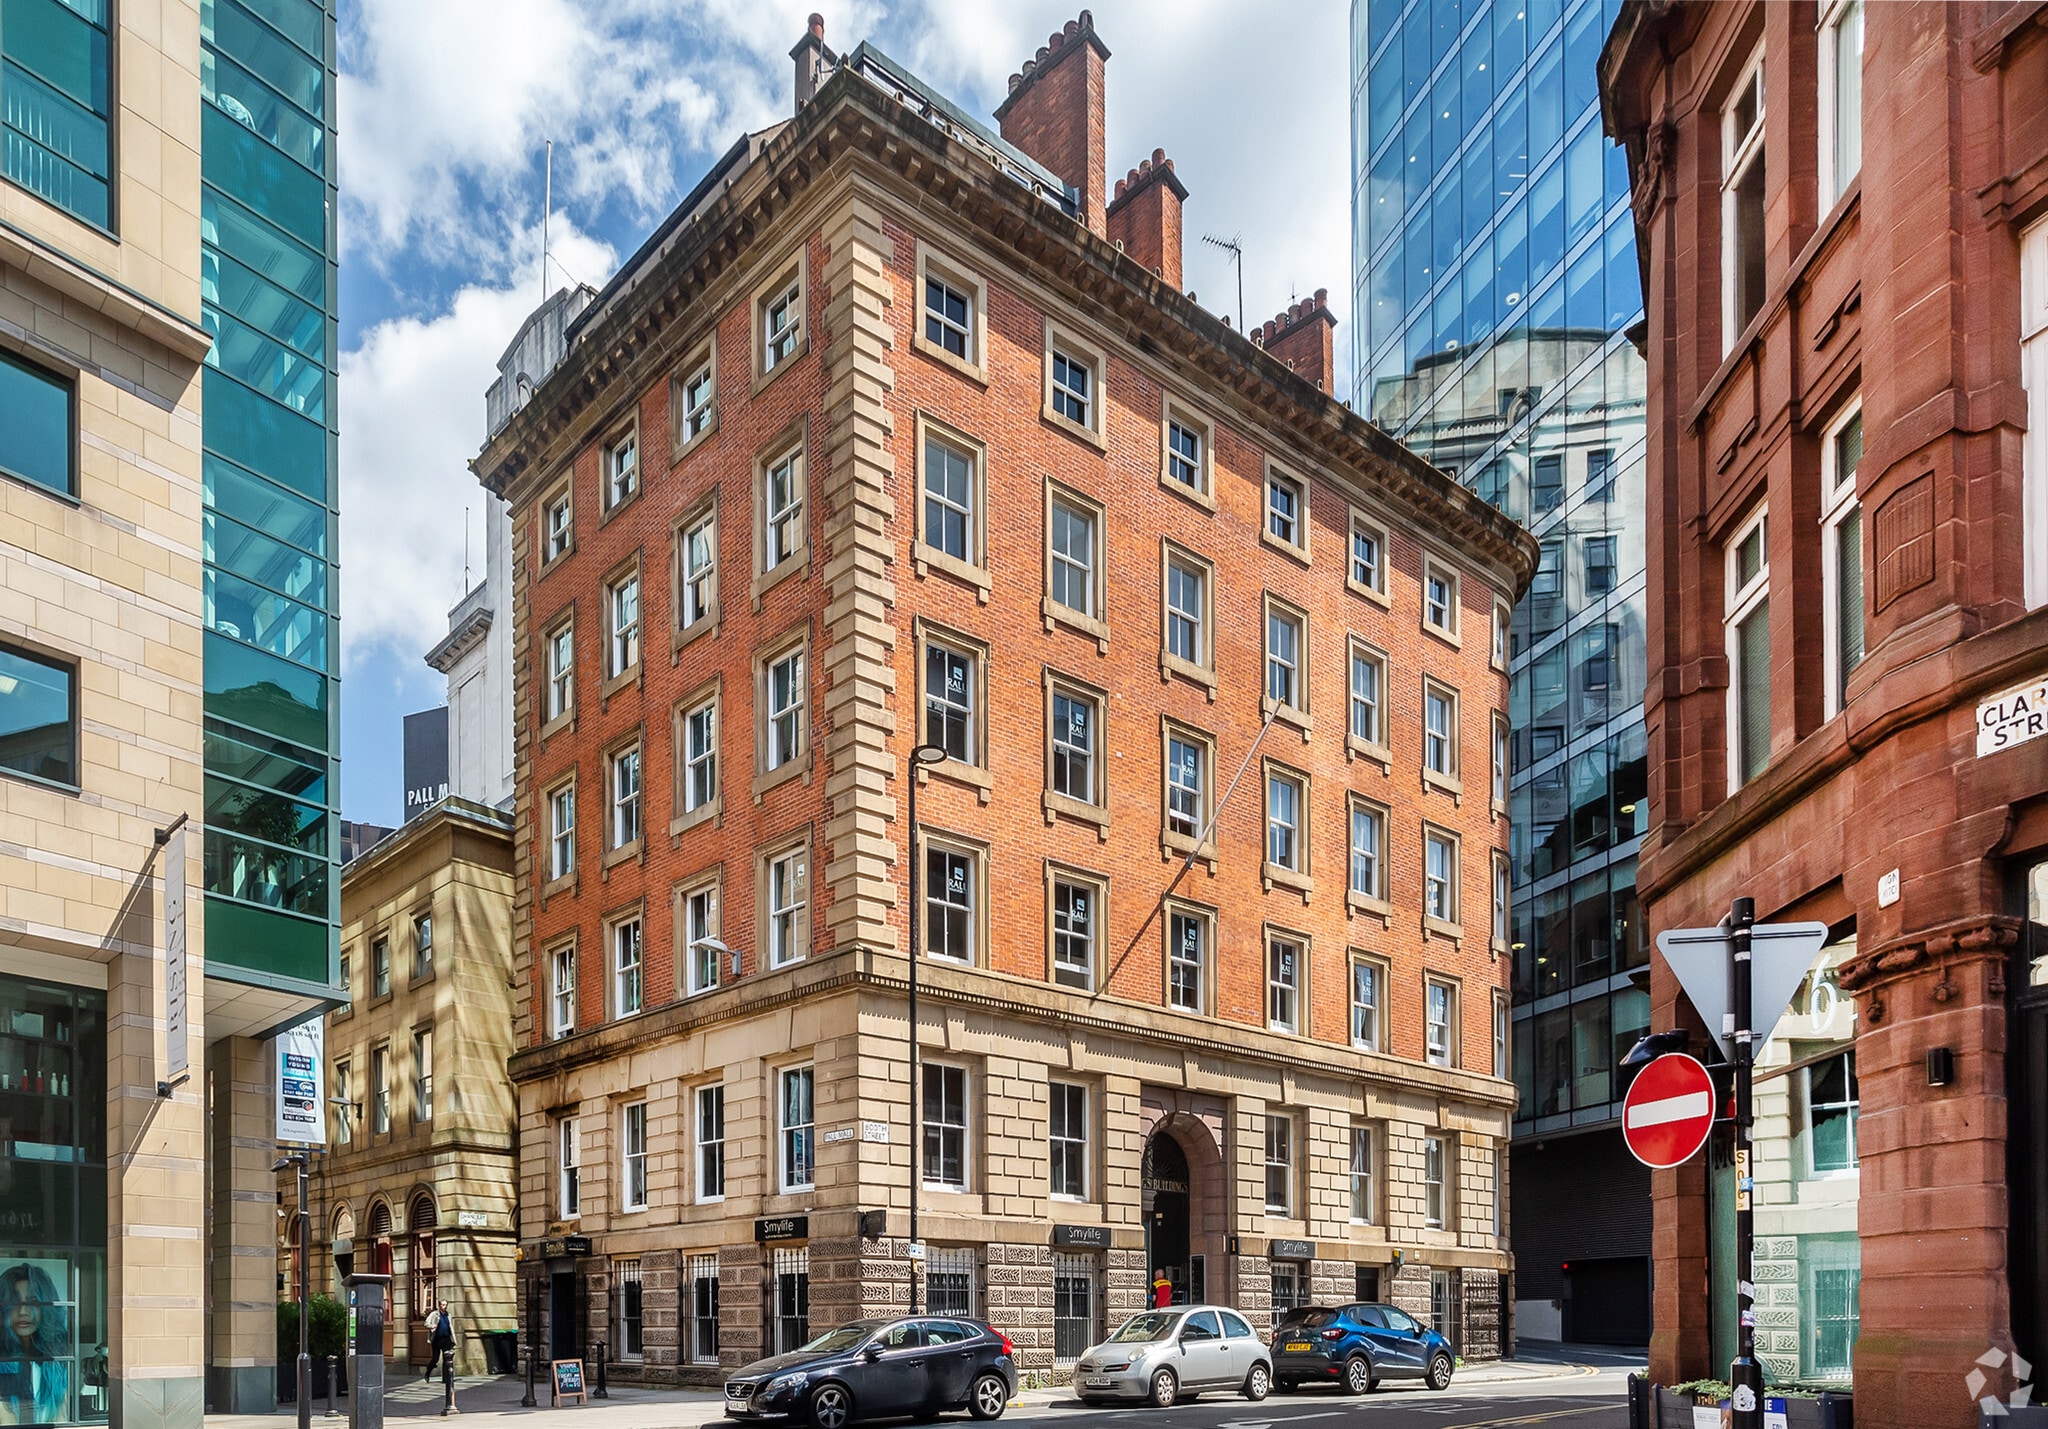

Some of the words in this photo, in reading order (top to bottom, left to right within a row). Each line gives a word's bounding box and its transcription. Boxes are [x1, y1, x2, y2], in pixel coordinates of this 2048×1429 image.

[1994, 711, 2048, 747] STR
[408, 786, 434, 805] PALL
[864, 1124, 887, 1133] BOOTH
[864, 1131, 885, 1140] STREET
[764, 1219, 794, 1234] Smylife
[1068, 1226, 1101, 1241] Smylife
[1282, 1240, 1308, 1253] Smylife
